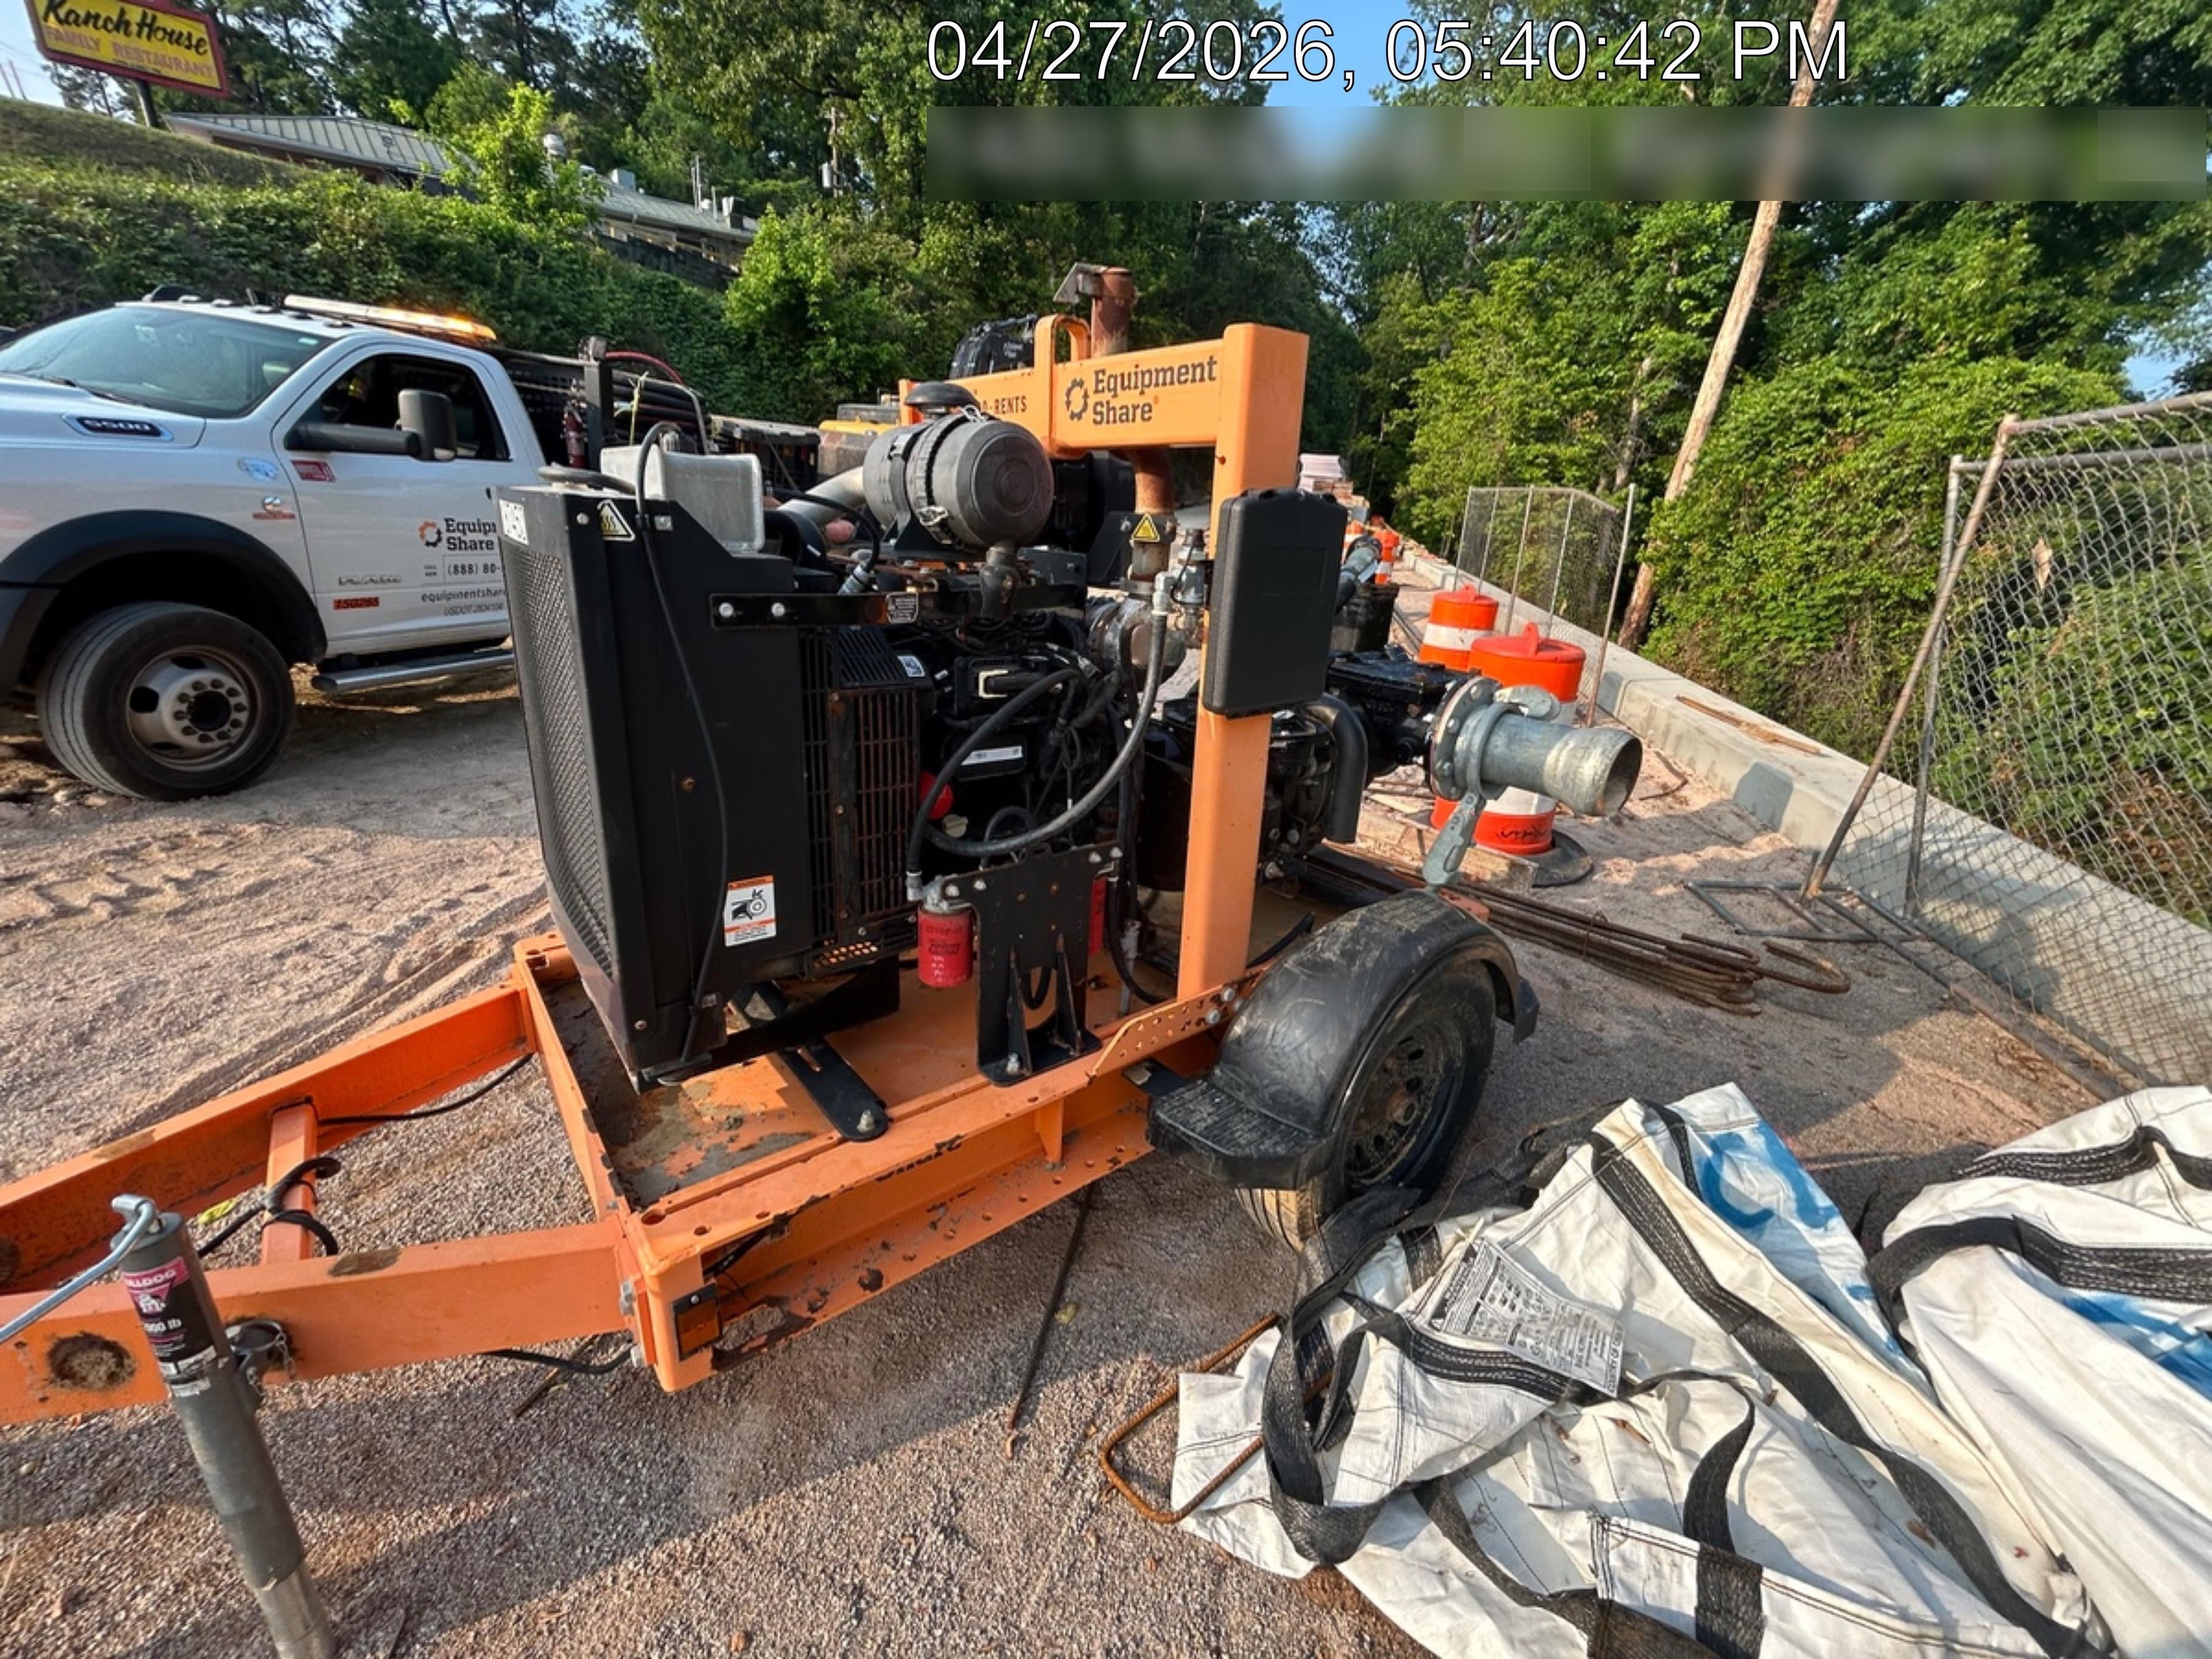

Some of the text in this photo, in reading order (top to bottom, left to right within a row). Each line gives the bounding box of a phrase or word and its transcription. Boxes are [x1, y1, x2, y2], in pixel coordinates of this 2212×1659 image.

[42, 0, 209, 56] Ranch House
[111, 41, 214, 78] RESTAURANT
[1092, 355, 1218, 398] Equipment
[1092, 401, 1153, 425] Share
[446, 536, 495, 551] Share
